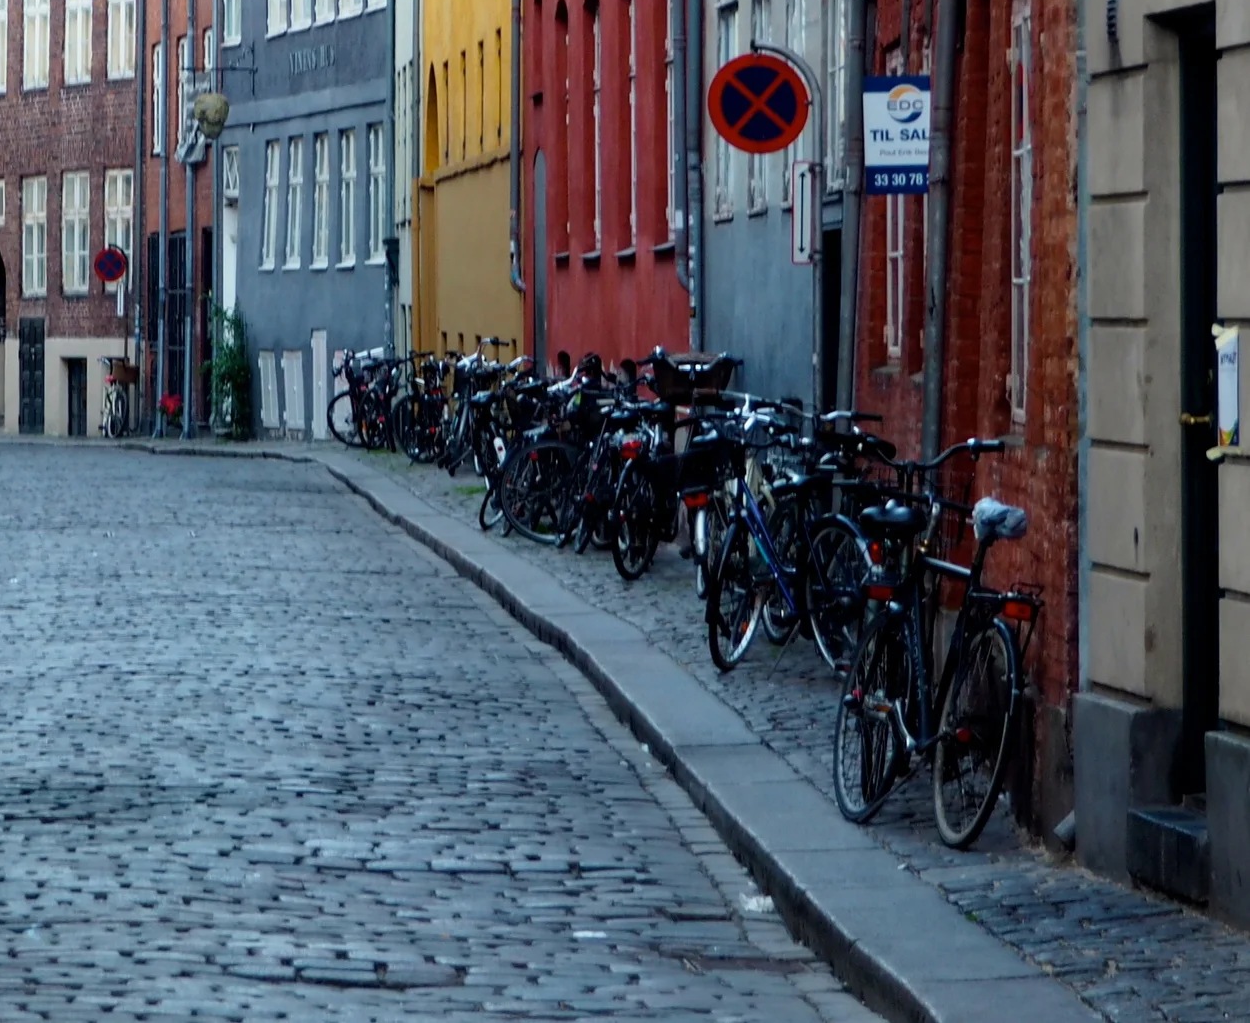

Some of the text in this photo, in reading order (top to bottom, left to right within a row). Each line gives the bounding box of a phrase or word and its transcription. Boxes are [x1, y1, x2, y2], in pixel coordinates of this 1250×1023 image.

[886, 99, 924, 111] EDC
[870, 128, 930, 142] TIL SAL
[874, 173, 889, 186] 33
[892, 173, 906, 186] 30
[909, 172, 924, 186] 78
